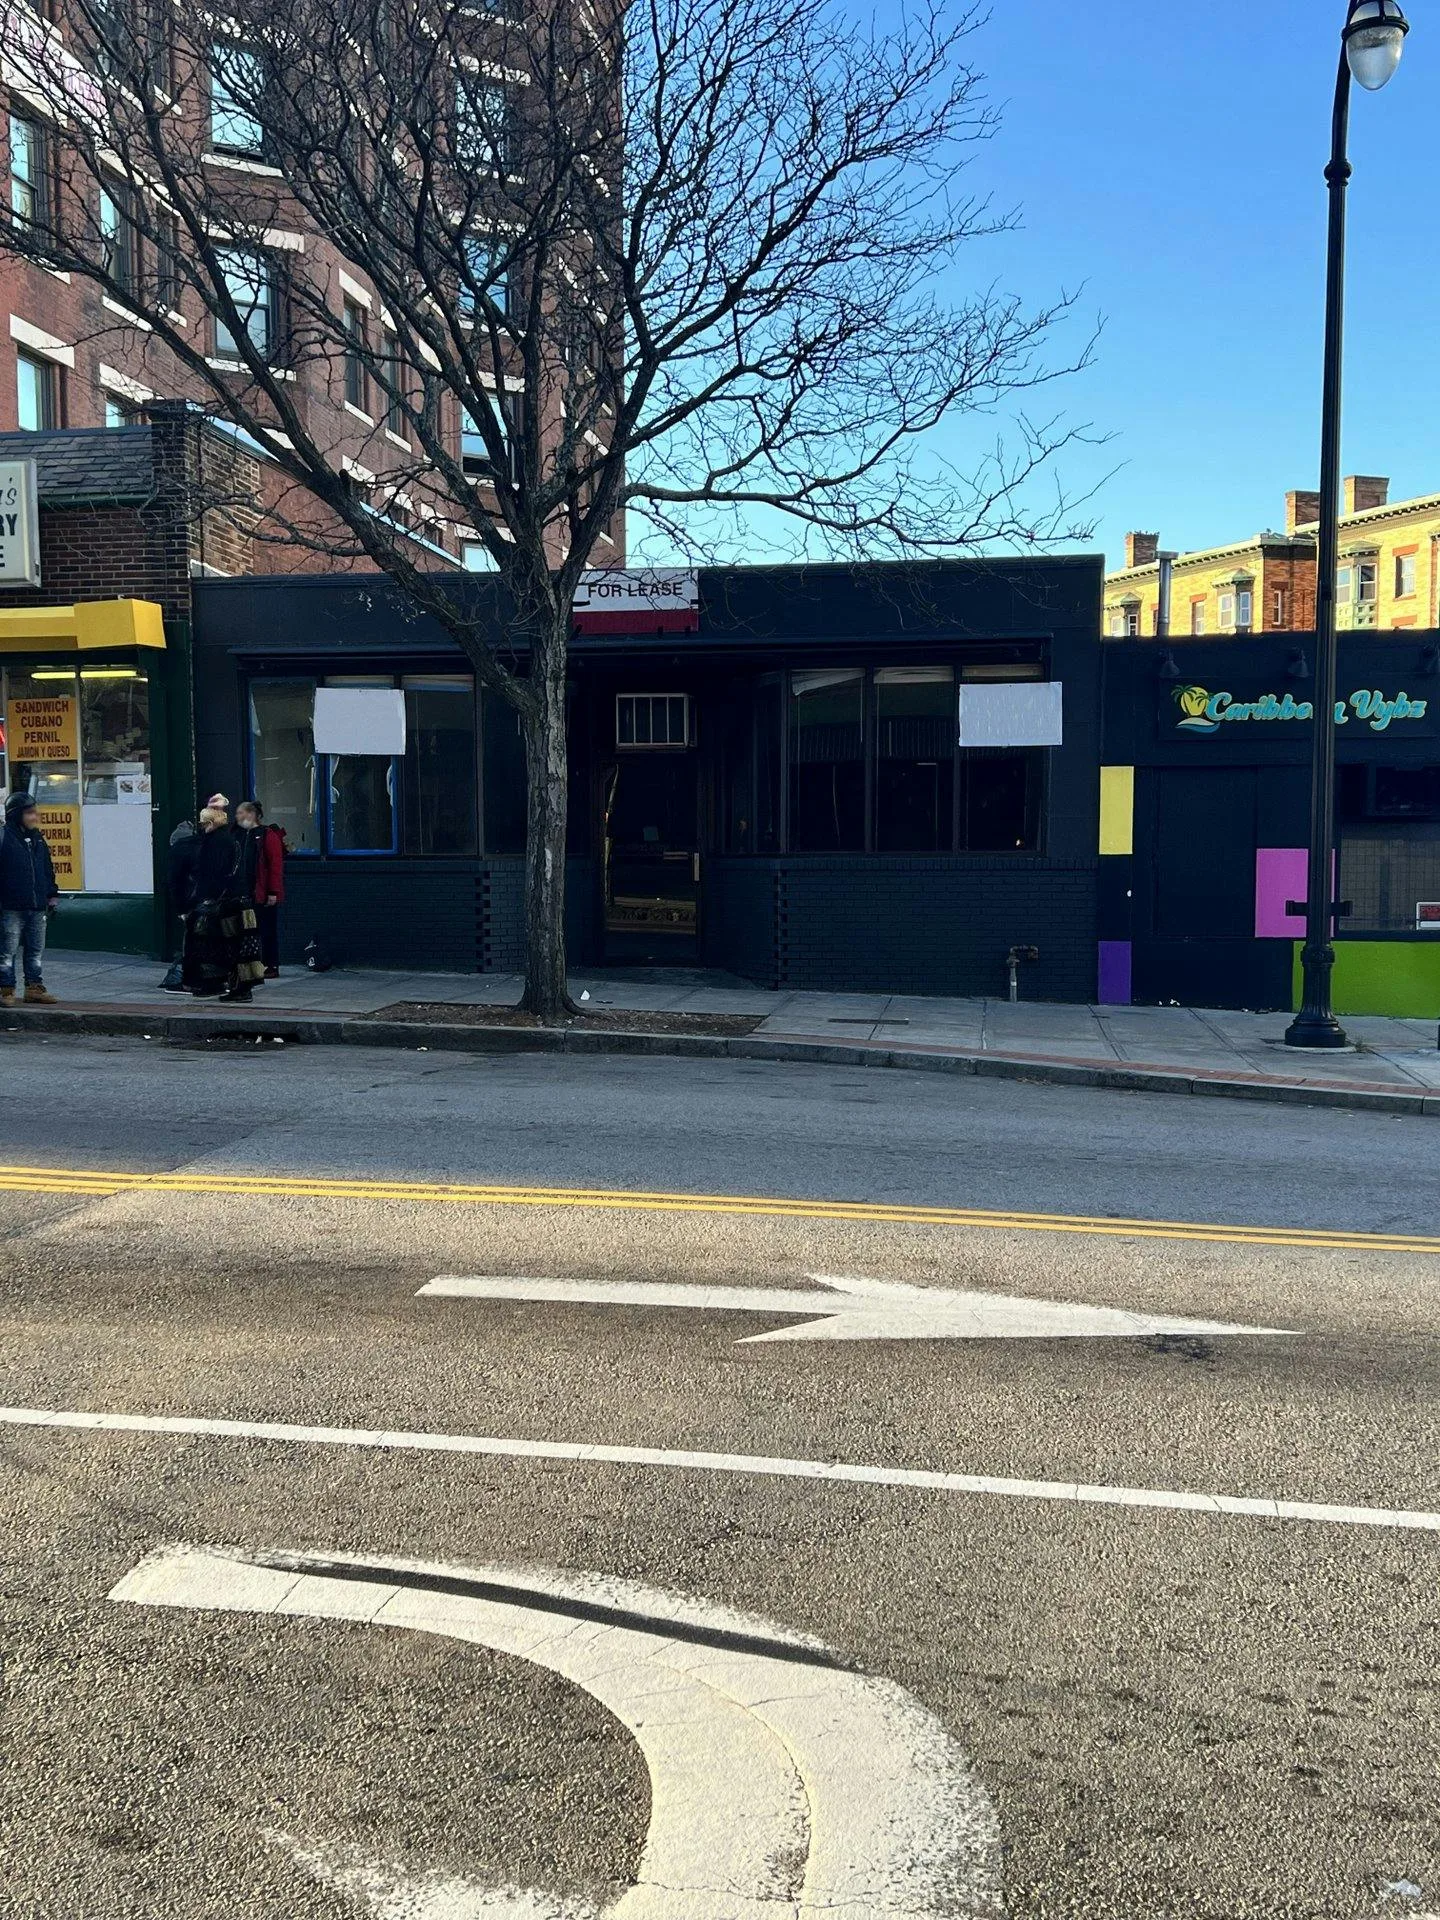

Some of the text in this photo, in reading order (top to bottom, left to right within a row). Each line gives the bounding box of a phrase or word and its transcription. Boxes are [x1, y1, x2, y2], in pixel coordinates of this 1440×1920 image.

[588, 582, 683, 598] FOR LEASE
[15, 700, 69, 714] SANDWICH
[1205, 689, 1428, 731] Caribben Vybz
[21, 715, 63, 728] CUBANO
[24, 731, 61, 743] PERNIL
[17, 745, 70, 758] JAMON Y QUESO
[40, 812, 72, 824] ELILLO
[58, 845, 73, 857] PAPA
[53, 862, 73, 874] RITA
